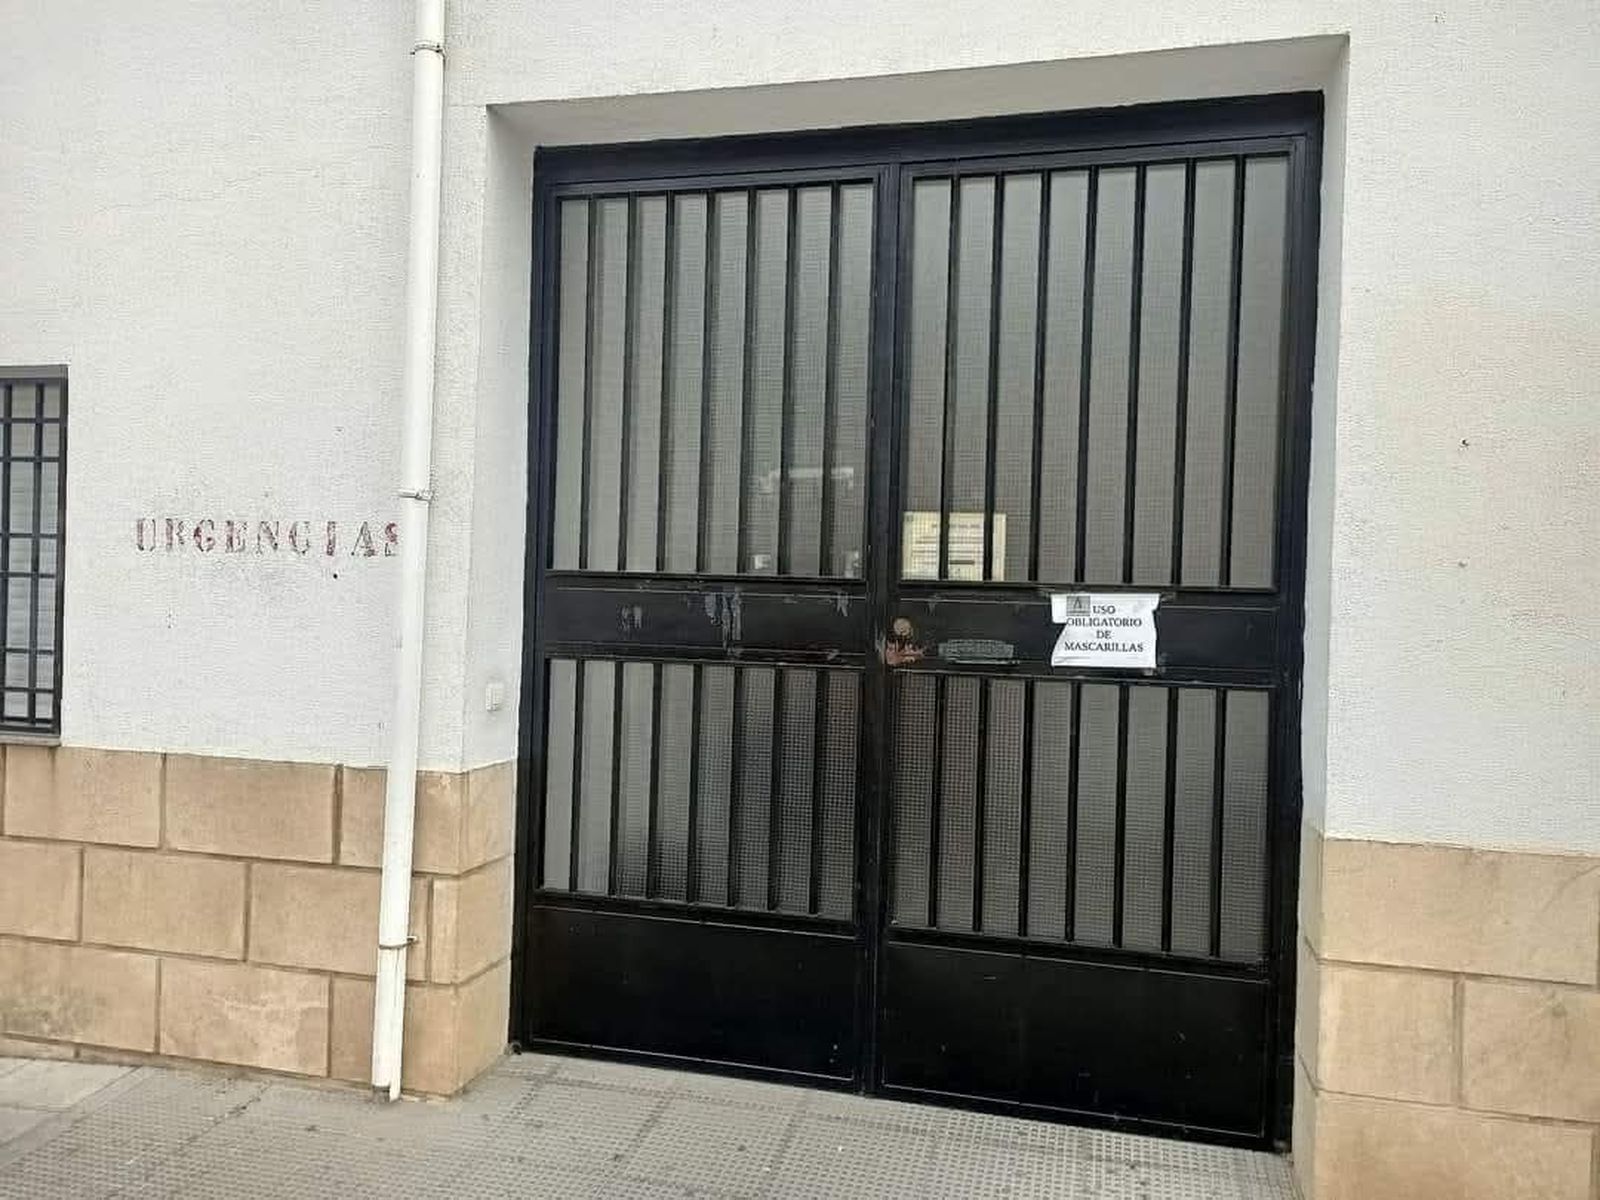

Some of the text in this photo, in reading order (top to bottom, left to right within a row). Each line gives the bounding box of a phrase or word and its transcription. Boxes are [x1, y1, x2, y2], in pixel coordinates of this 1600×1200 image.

[136, 518, 398, 557] URGENCIAS
[1092, 605, 1116, 614] USO
[1066, 617, 1142, 627] OBLIGATORIO
[1096, 630, 1112, 639] DE
[1064, 641, 1144, 652] MASCARILLAS
